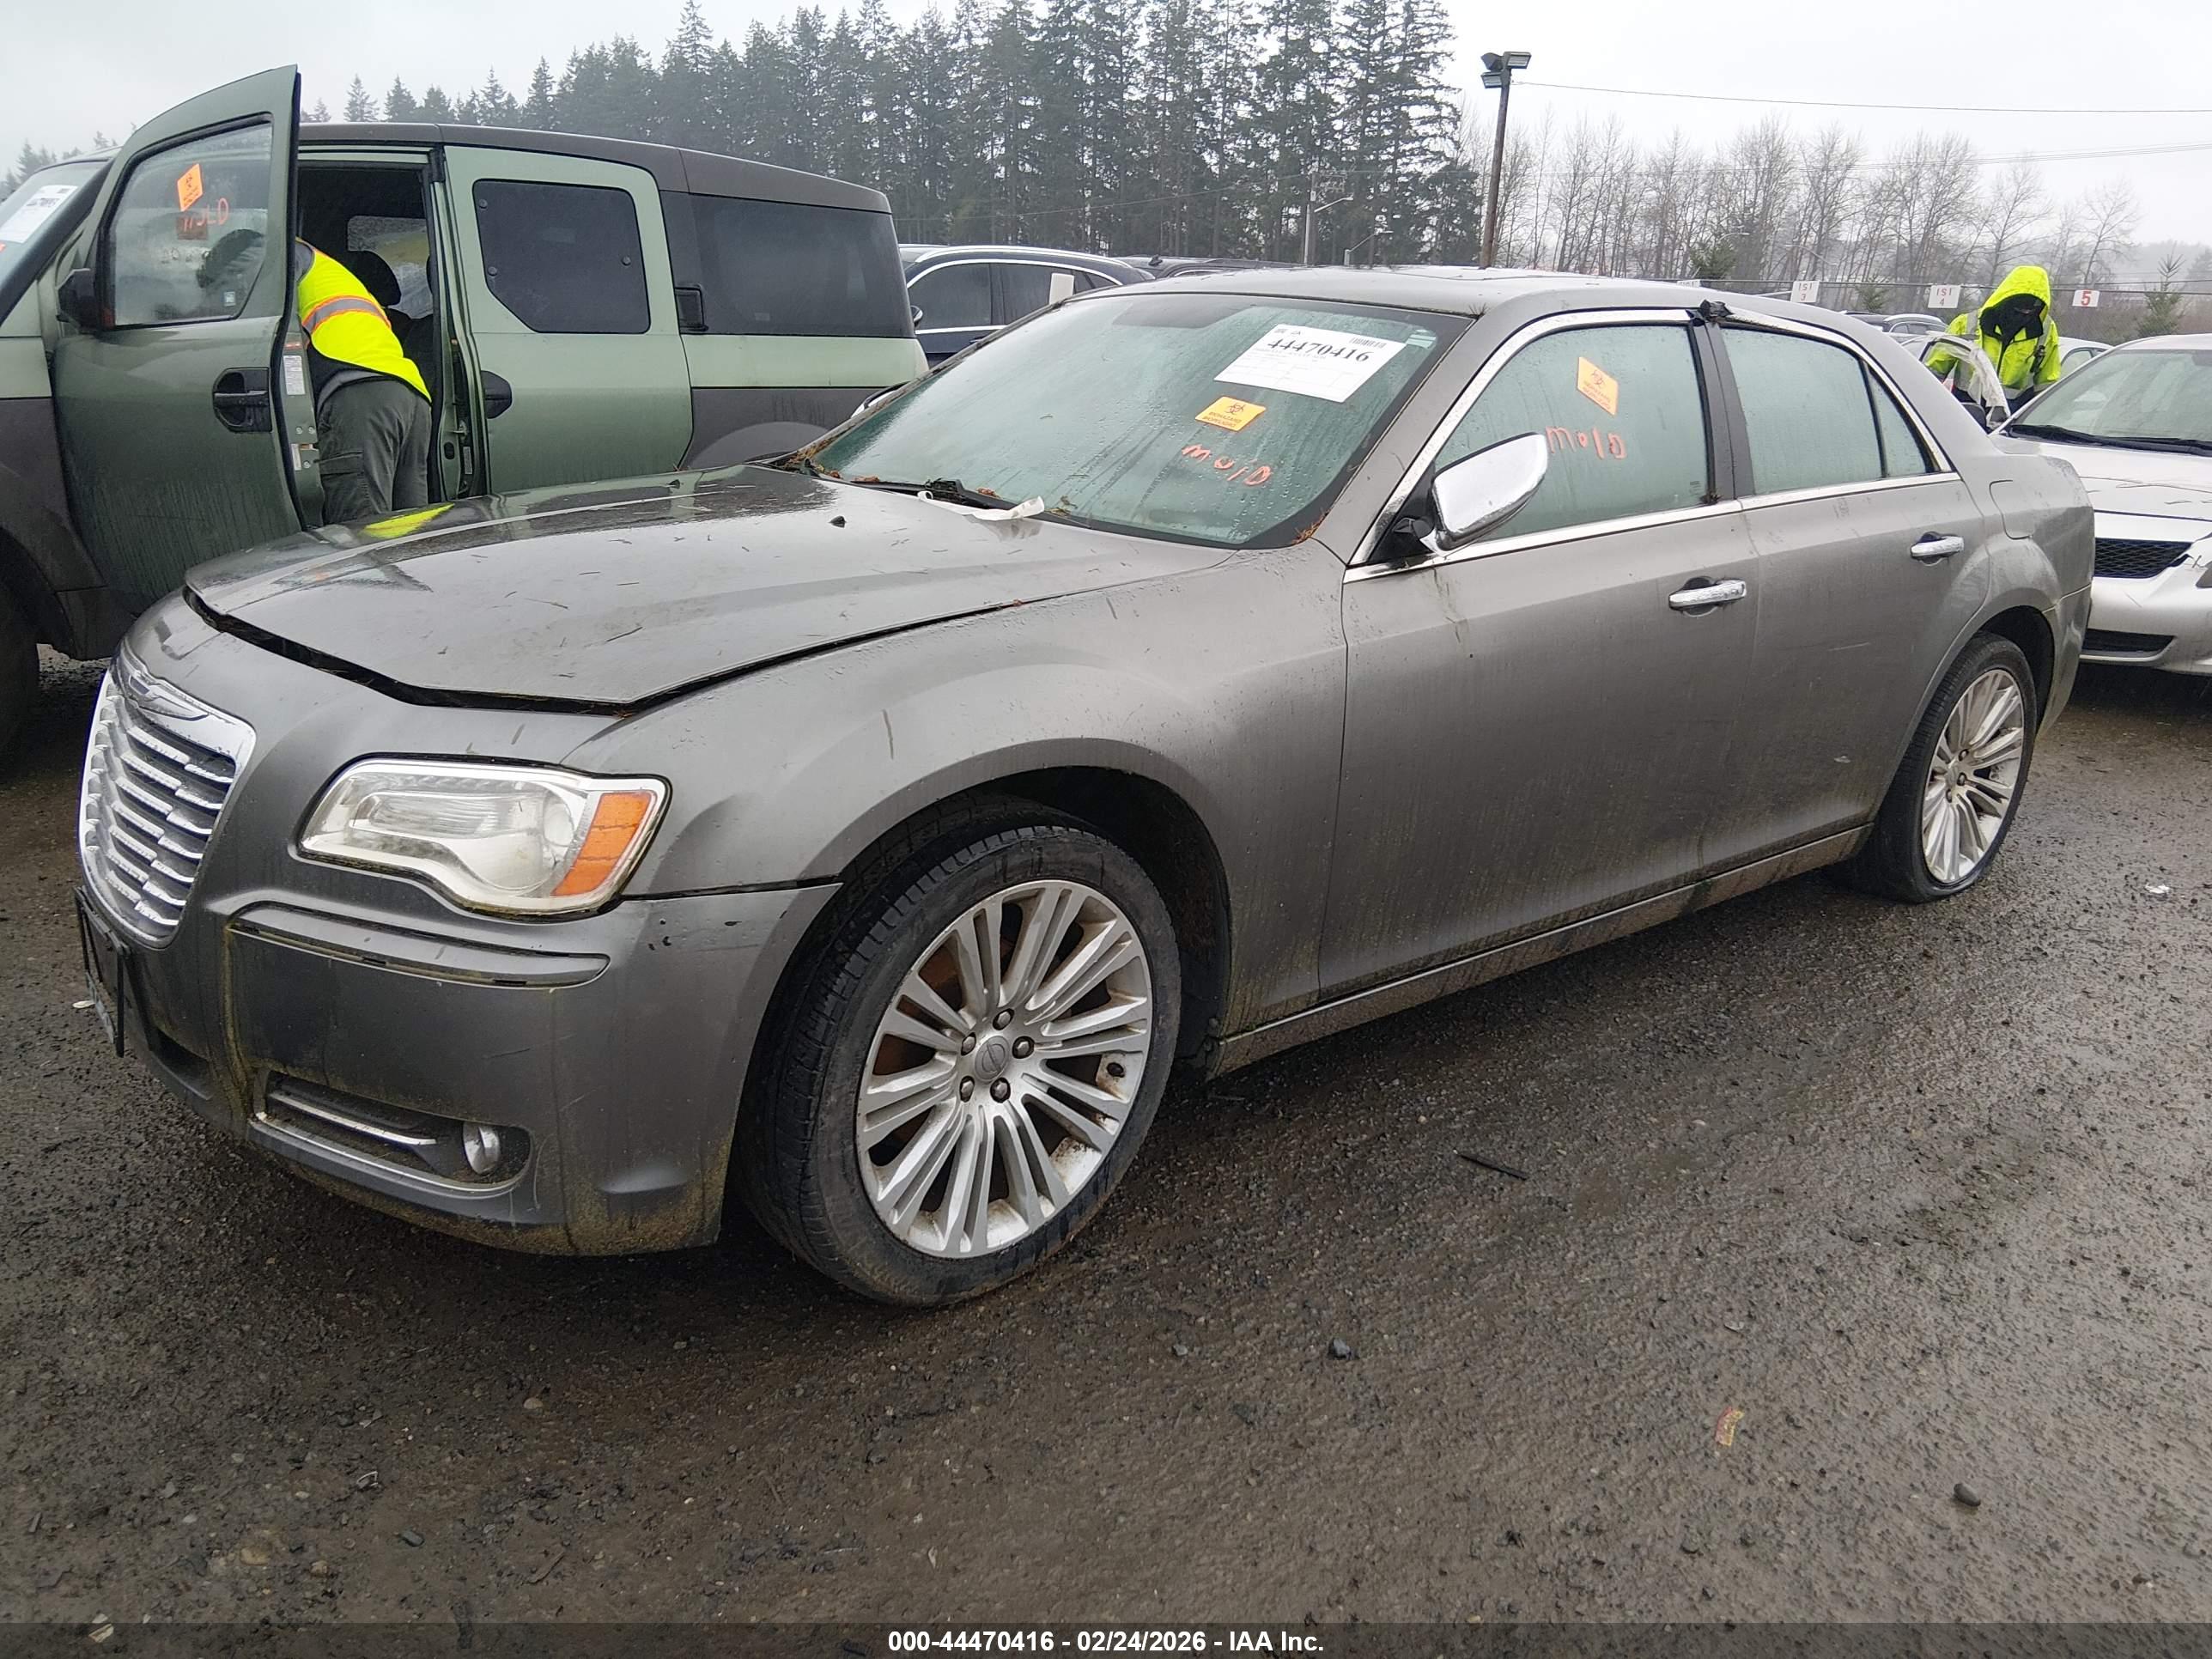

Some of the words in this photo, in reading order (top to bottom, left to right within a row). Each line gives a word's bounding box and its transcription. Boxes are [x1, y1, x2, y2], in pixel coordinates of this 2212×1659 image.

[1939, 297, 1945, 307] 4
[2081, 290, 2092, 306] 5
[1267, 338, 1374, 362] 44470416
